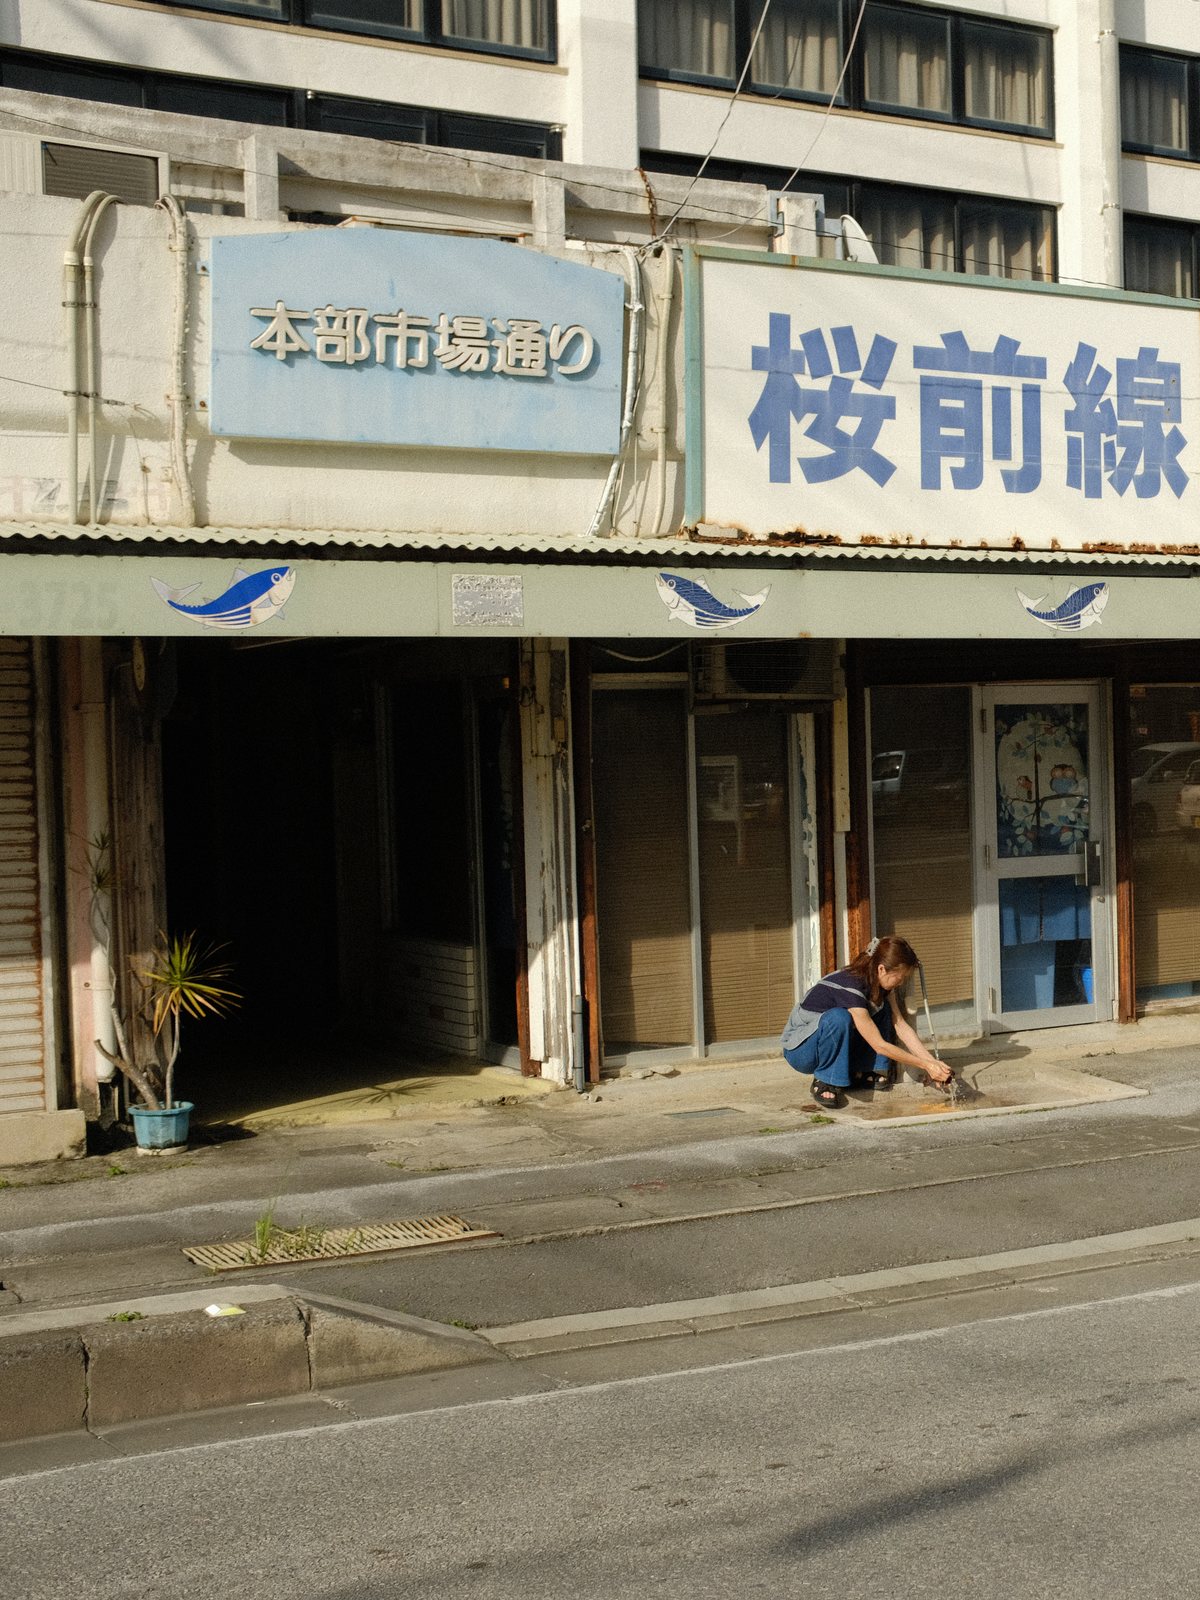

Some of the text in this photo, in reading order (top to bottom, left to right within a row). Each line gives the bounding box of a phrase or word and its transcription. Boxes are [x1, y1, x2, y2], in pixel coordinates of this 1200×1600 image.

[249, 300, 595, 378] 本部市場通り
